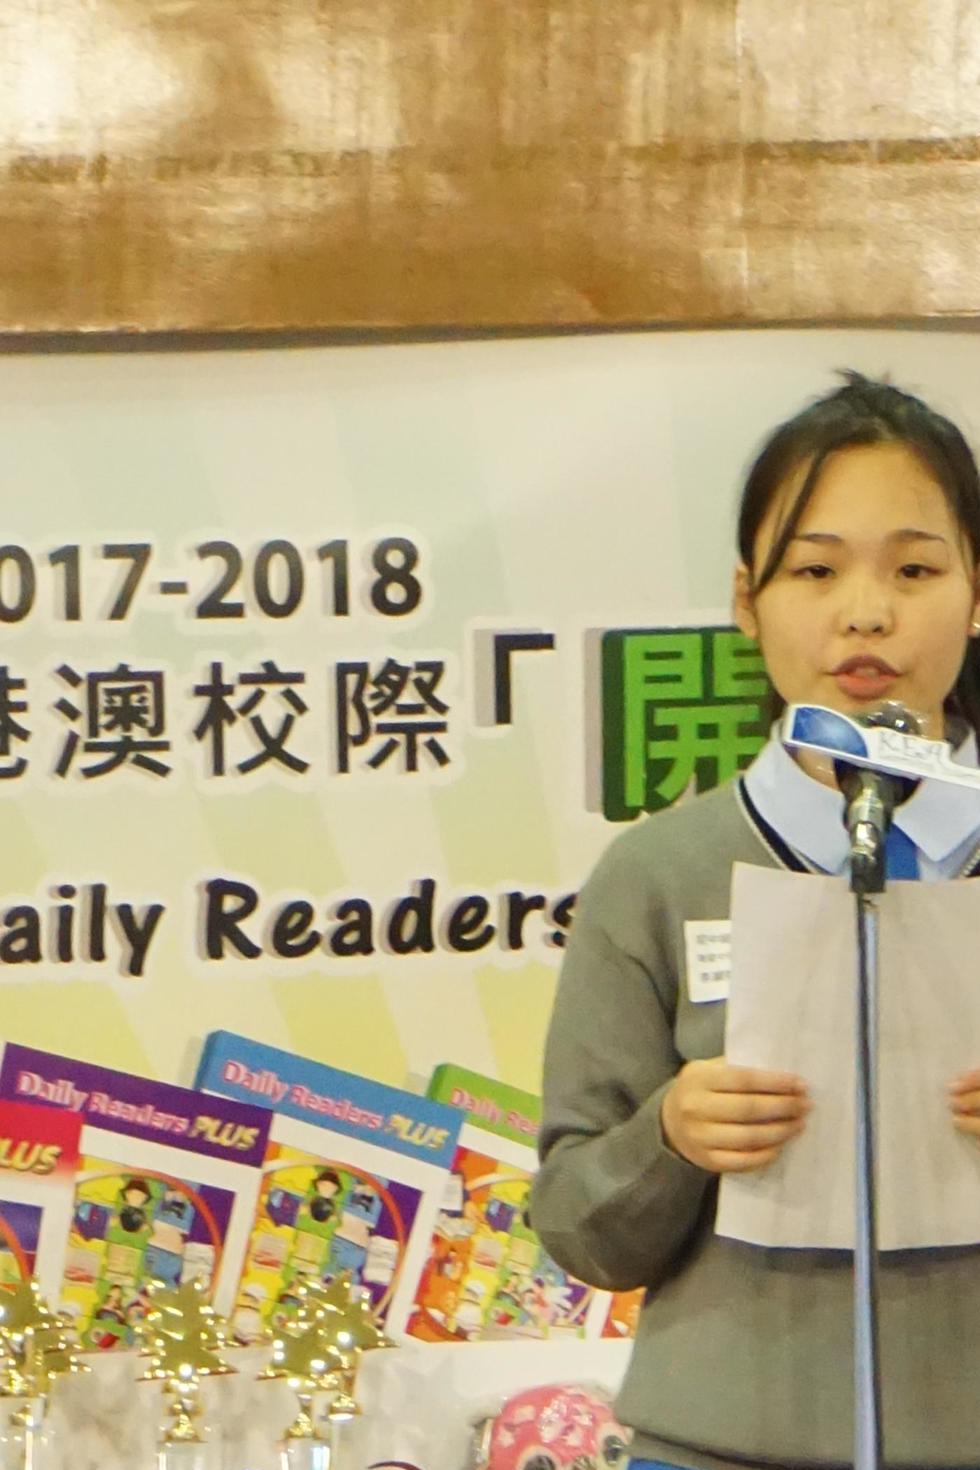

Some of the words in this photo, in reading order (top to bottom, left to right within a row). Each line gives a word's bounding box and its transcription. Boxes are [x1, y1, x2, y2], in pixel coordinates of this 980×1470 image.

[17, 1071, 88, 1113] Daily
[89, 1090, 190, 1133] Readers
[188, 1115, 259, 1151] PLUS
[223, 1060, 288, 1102] Daily
[287, 1085, 383, 1130] Readers
[382, 1113, 450, 1150] PLUS
